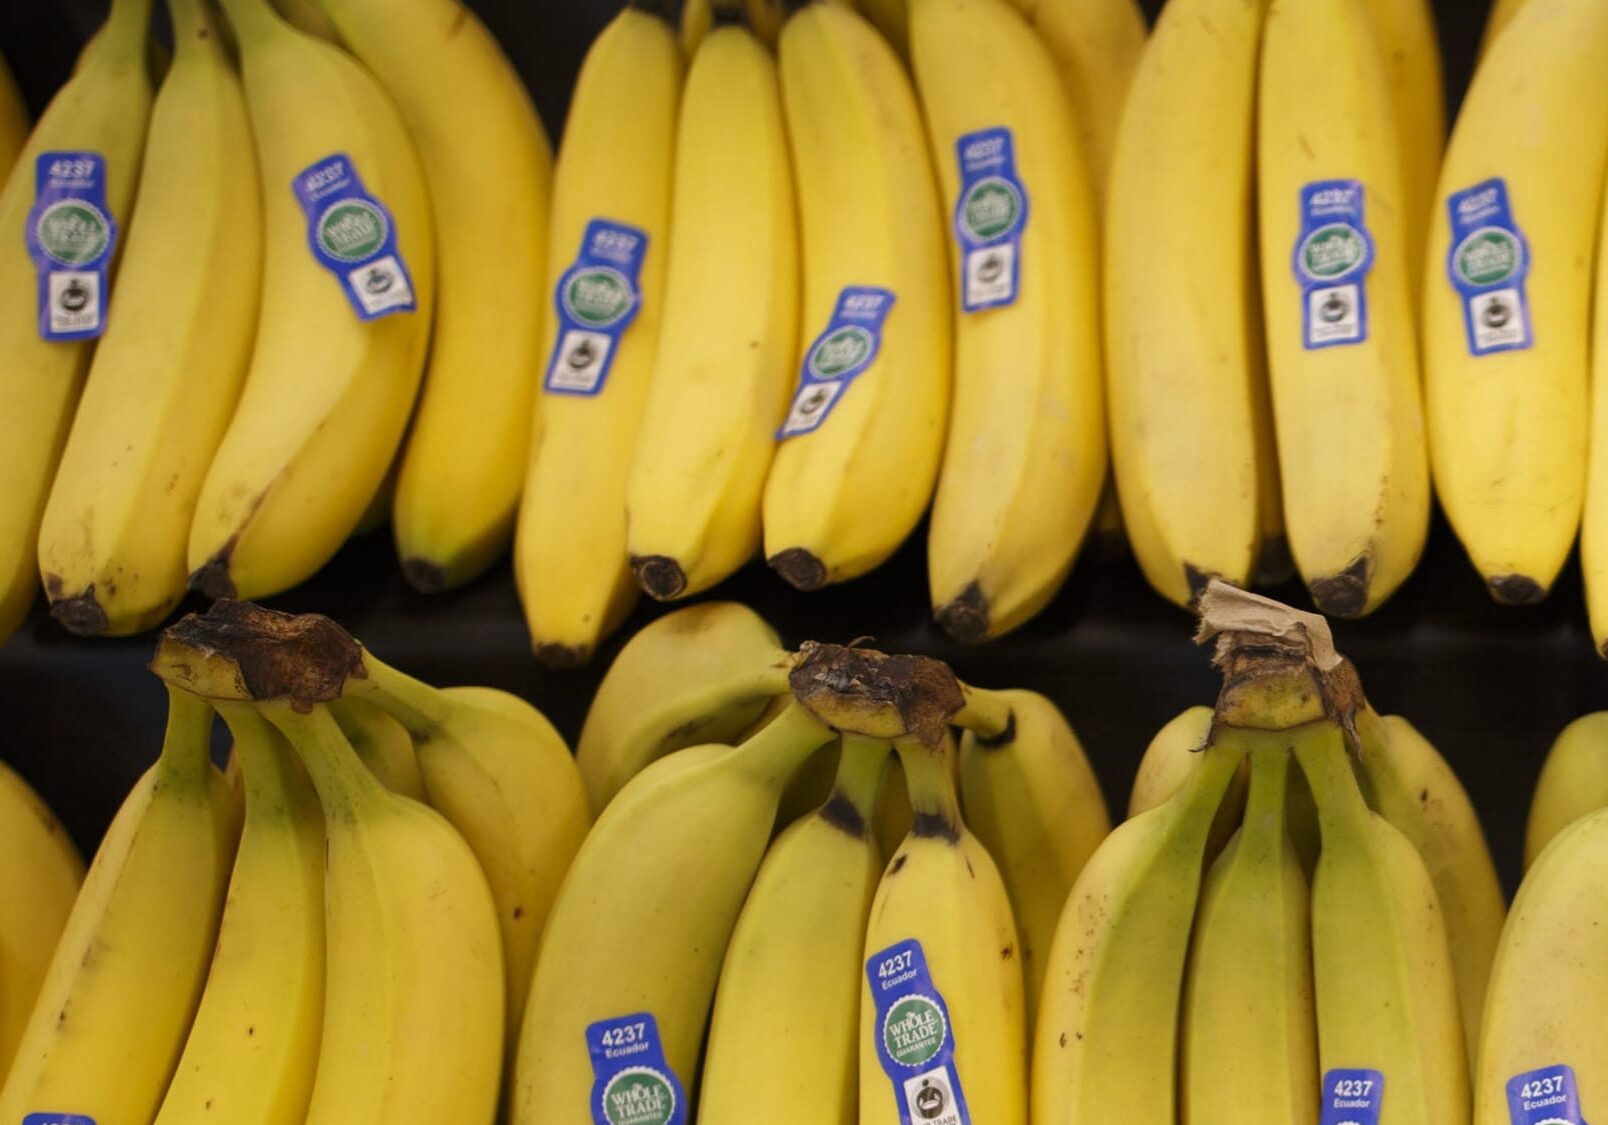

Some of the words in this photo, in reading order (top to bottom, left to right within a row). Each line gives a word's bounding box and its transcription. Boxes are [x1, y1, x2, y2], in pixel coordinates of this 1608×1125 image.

[878, 950, 914, 978] 4237
[882, 968, 918, 991] Ecuador
[889, 1009, 938, 1036] WHOLE
[601, 1023, 646, 1047] 4237
[893, 1025, 938, 1049] TRADE
[605, 1042, 649, 1059] Ecuador
[611, 1085, 662, 1107] WHOLE
[1334, 1080, 1373, 1096] 4237
[1521, 1076, 1564, 1098] 4237
[615, 1100, 665, 1118] TRADE
[1333, 1098, 1370, 1109] Ecuador
[1523, 1094, 1568, 1111] Ecuador
